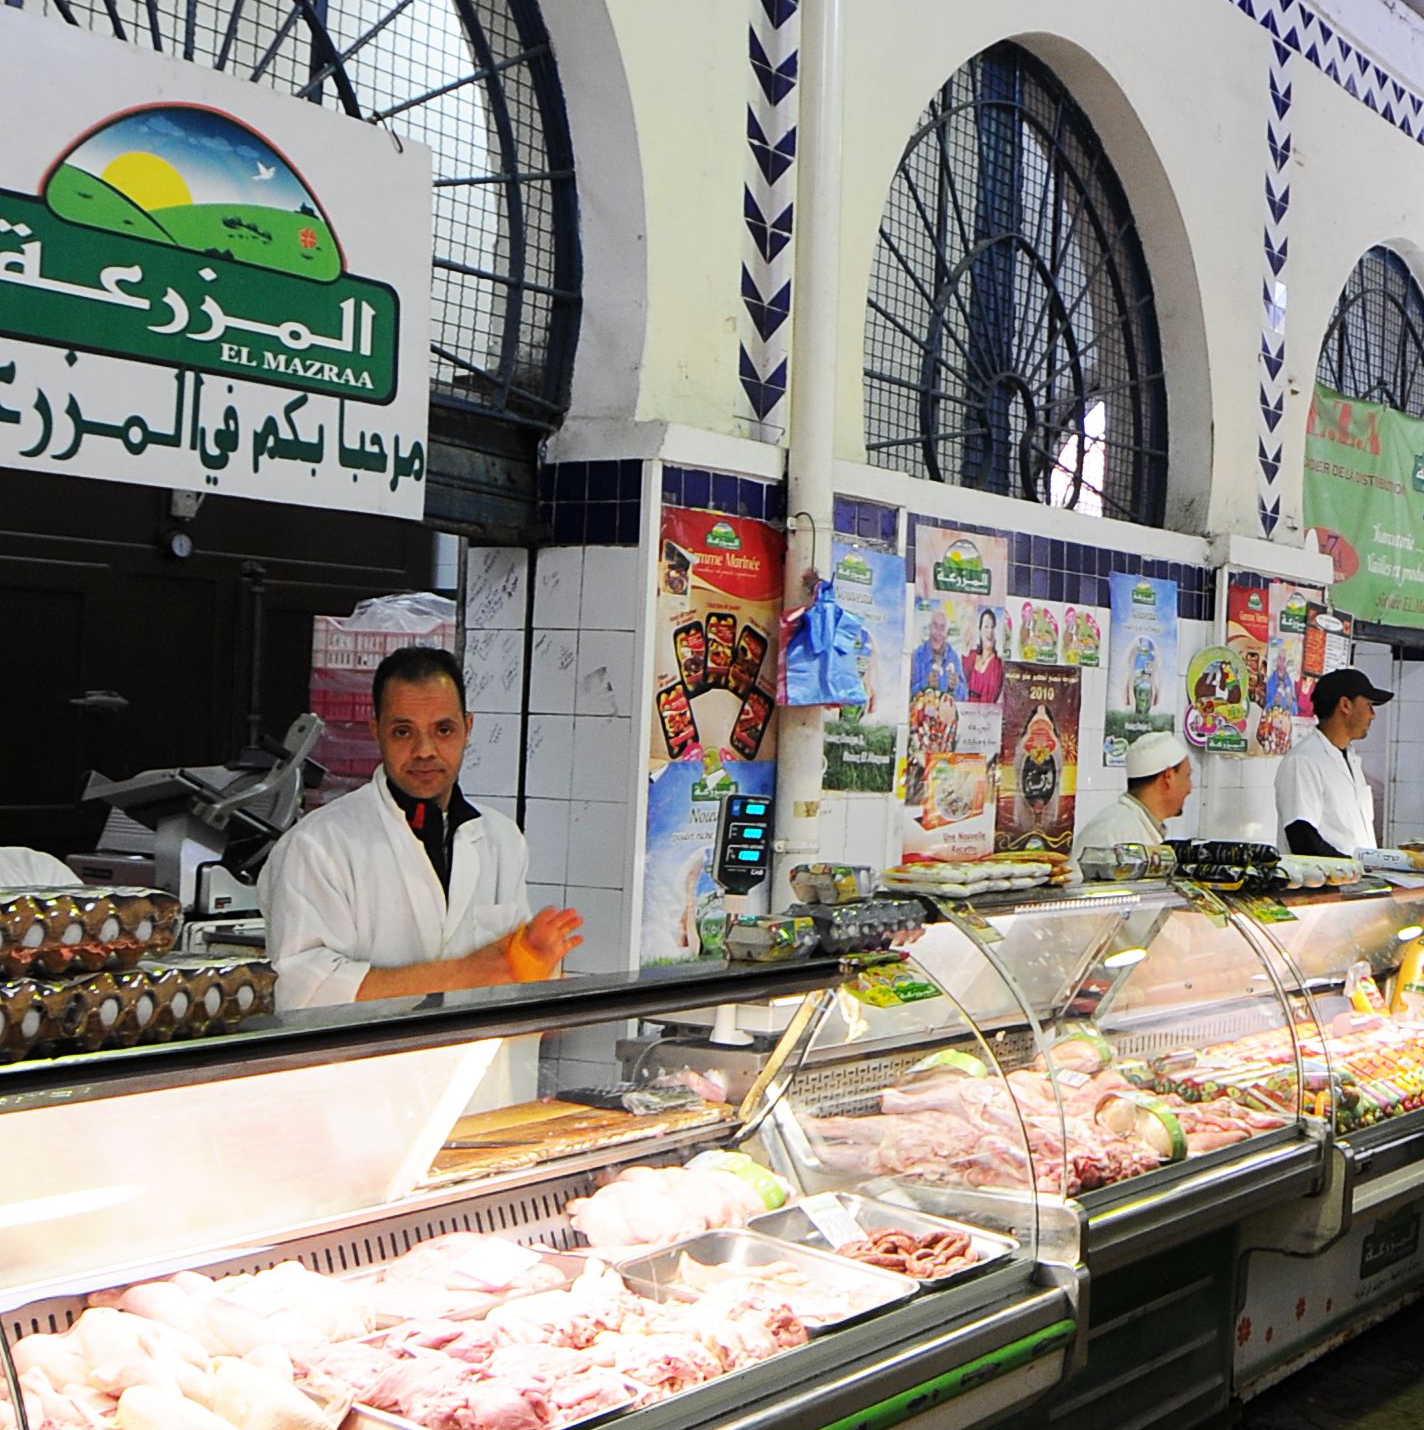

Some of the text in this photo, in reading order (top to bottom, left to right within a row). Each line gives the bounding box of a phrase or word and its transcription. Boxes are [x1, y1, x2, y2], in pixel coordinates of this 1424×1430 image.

[219, 342, 375, 390] EL MAZRAA
[200, 384, 240, 486] في
[253, 392, 325, 477] بكم
[339, 396, 425, 492] مرحبا
[1030, 686, 1055, 701] 2010
